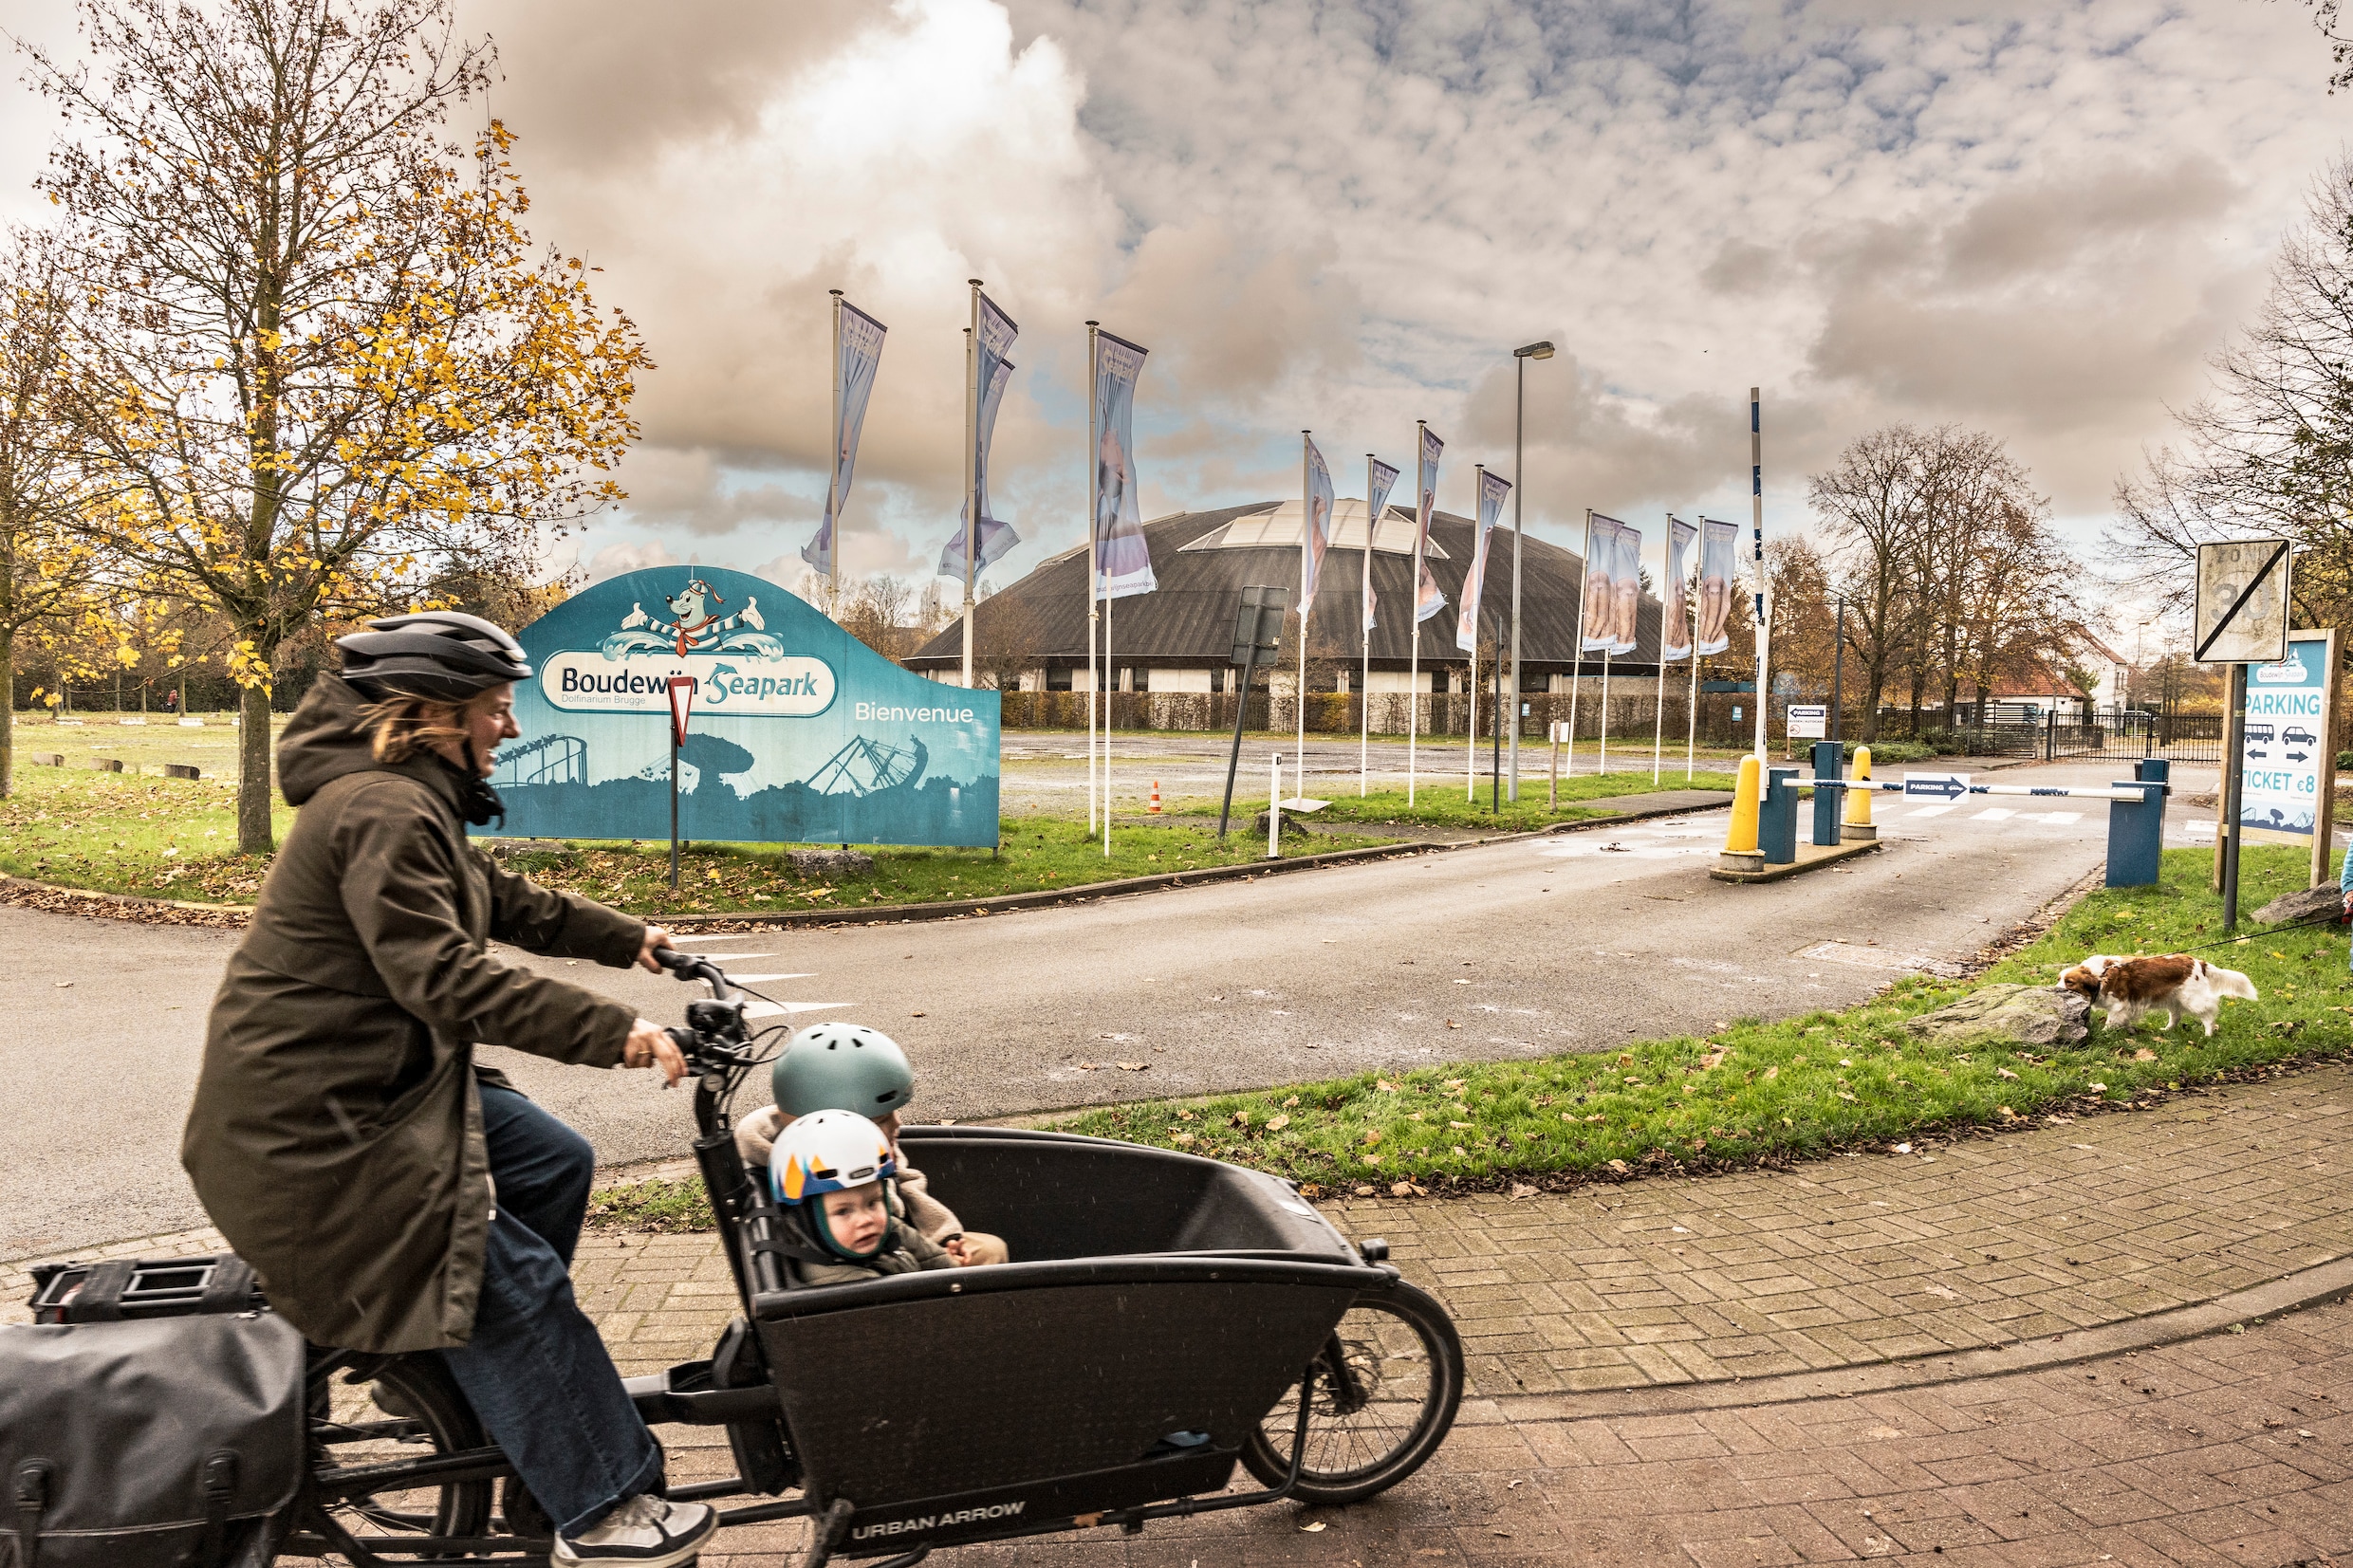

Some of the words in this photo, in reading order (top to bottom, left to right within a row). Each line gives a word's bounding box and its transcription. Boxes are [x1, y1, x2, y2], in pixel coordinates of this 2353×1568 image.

[1101, 347, 1137, 381] Seapark
[2210, 581, 2270, 621] 30
[704, 663, 819, 704] Seapark
[562, 693, 611, 703] Dolfinarium
[614, 695, 646, 706] Brugge
[855, 701, 974, 723] Bienvenue
[1910, 783, 1944, 791] PARKING
[2297, 774, 2315, 793] €8
[852, 1516, 936, 1540] URBAN
[937, 1501, 1027, 1526] ARROW
